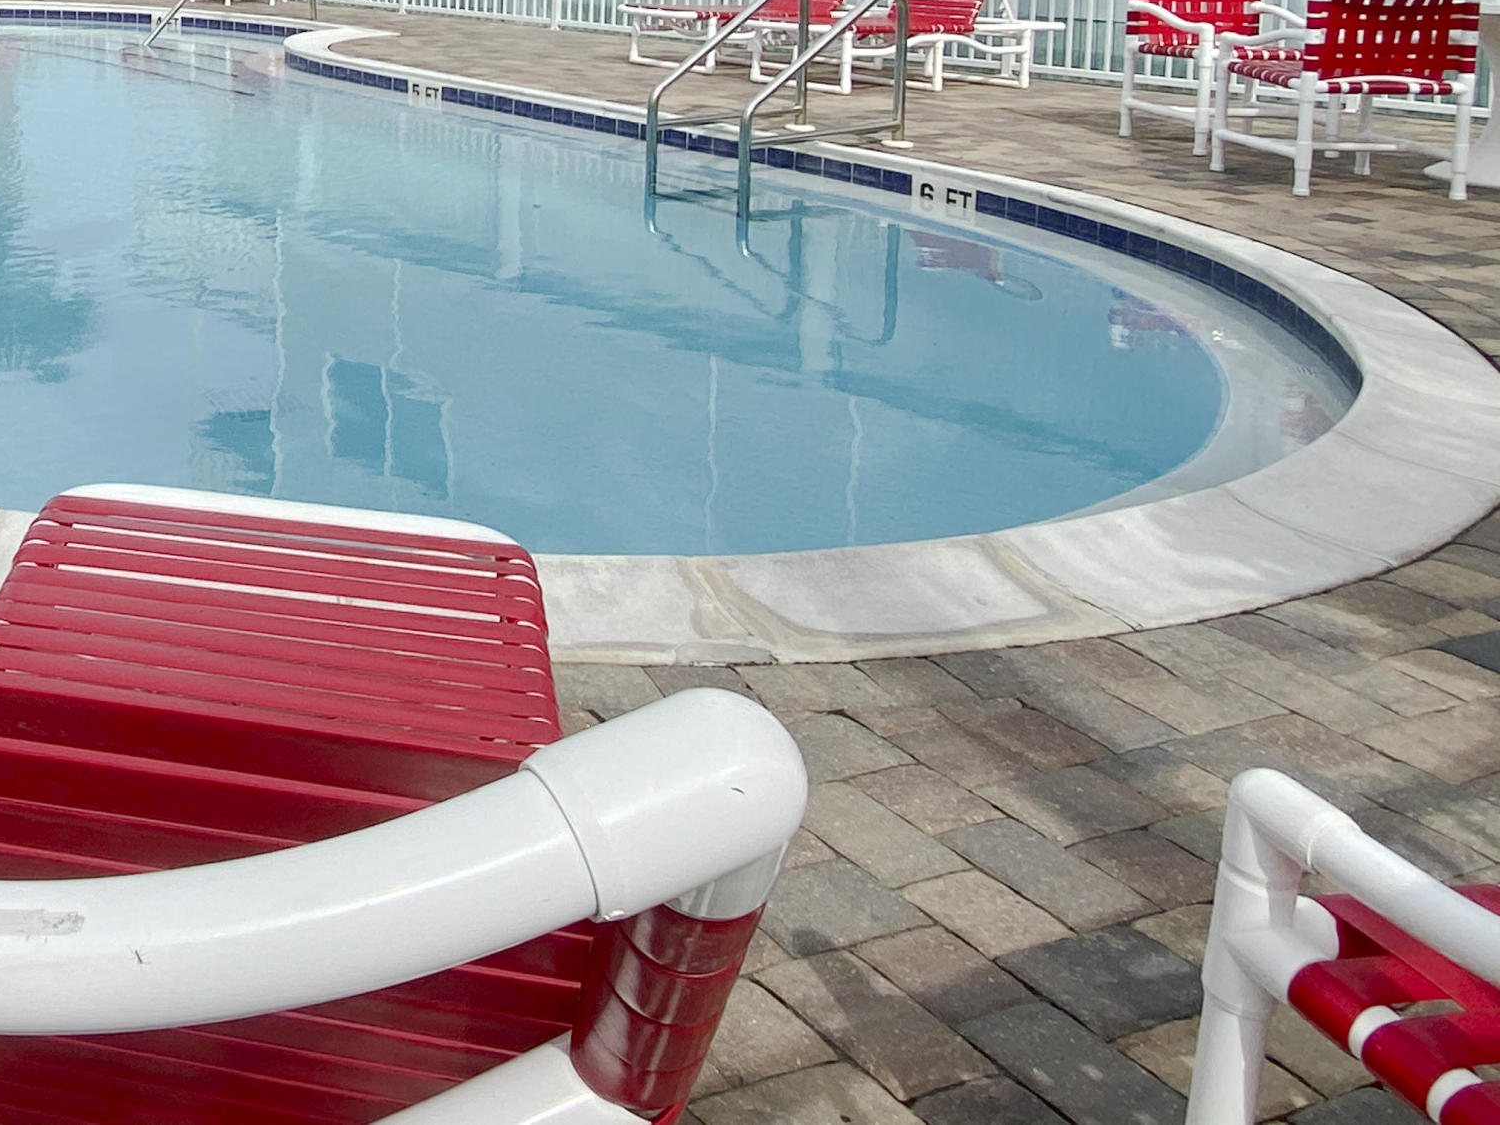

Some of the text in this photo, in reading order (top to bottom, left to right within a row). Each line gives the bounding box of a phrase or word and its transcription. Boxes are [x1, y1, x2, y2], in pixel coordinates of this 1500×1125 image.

[412, 83, 440, 100] 5 FT
[920, 182, 973, 209] 6 FT
